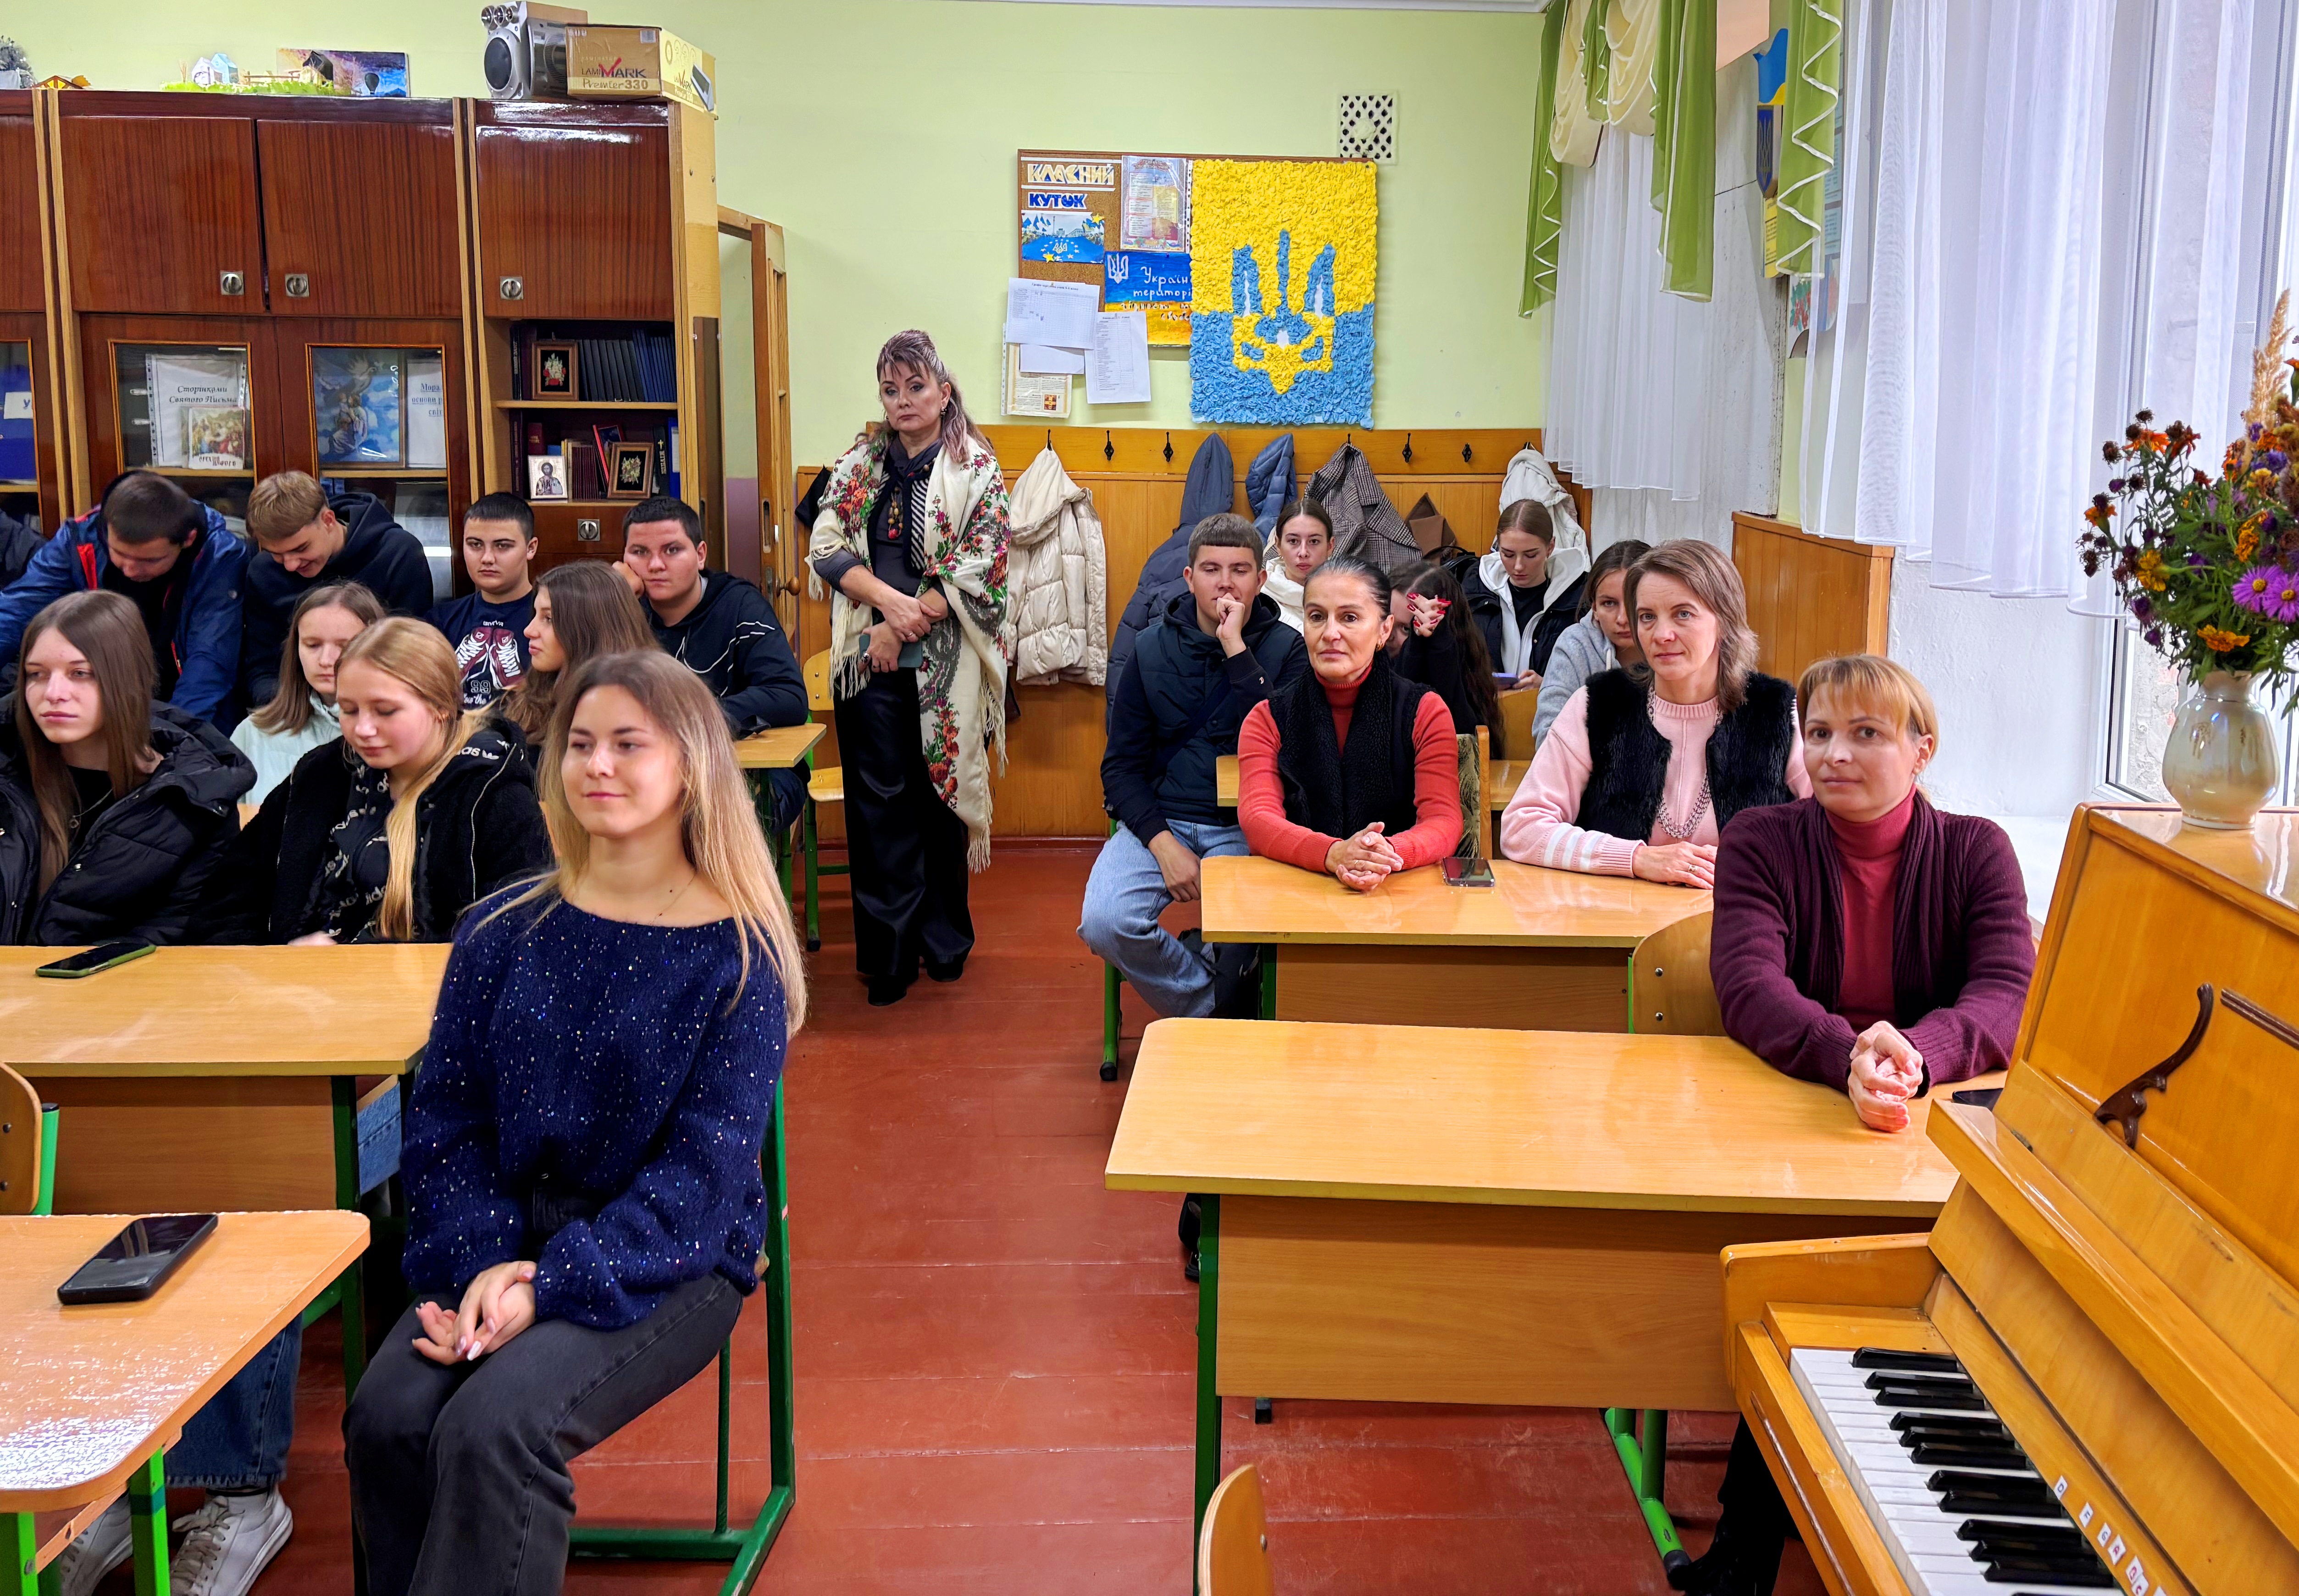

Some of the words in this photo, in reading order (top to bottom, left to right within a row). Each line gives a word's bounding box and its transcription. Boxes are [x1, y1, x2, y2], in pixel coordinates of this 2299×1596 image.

[583, 78, 623, 89] Premier
[624, 79, 648, 89] 330
[1028, 164, 1114, 184] КЛАСНИЙ
[1029, 193, 1086, 208] КУТОК
[1141, 266, 1188, 292] Україн
[1133, 288, 1191, 300] територі
[421, 383, 440, 392] Мора
[471, 680, 491, 694] 99
